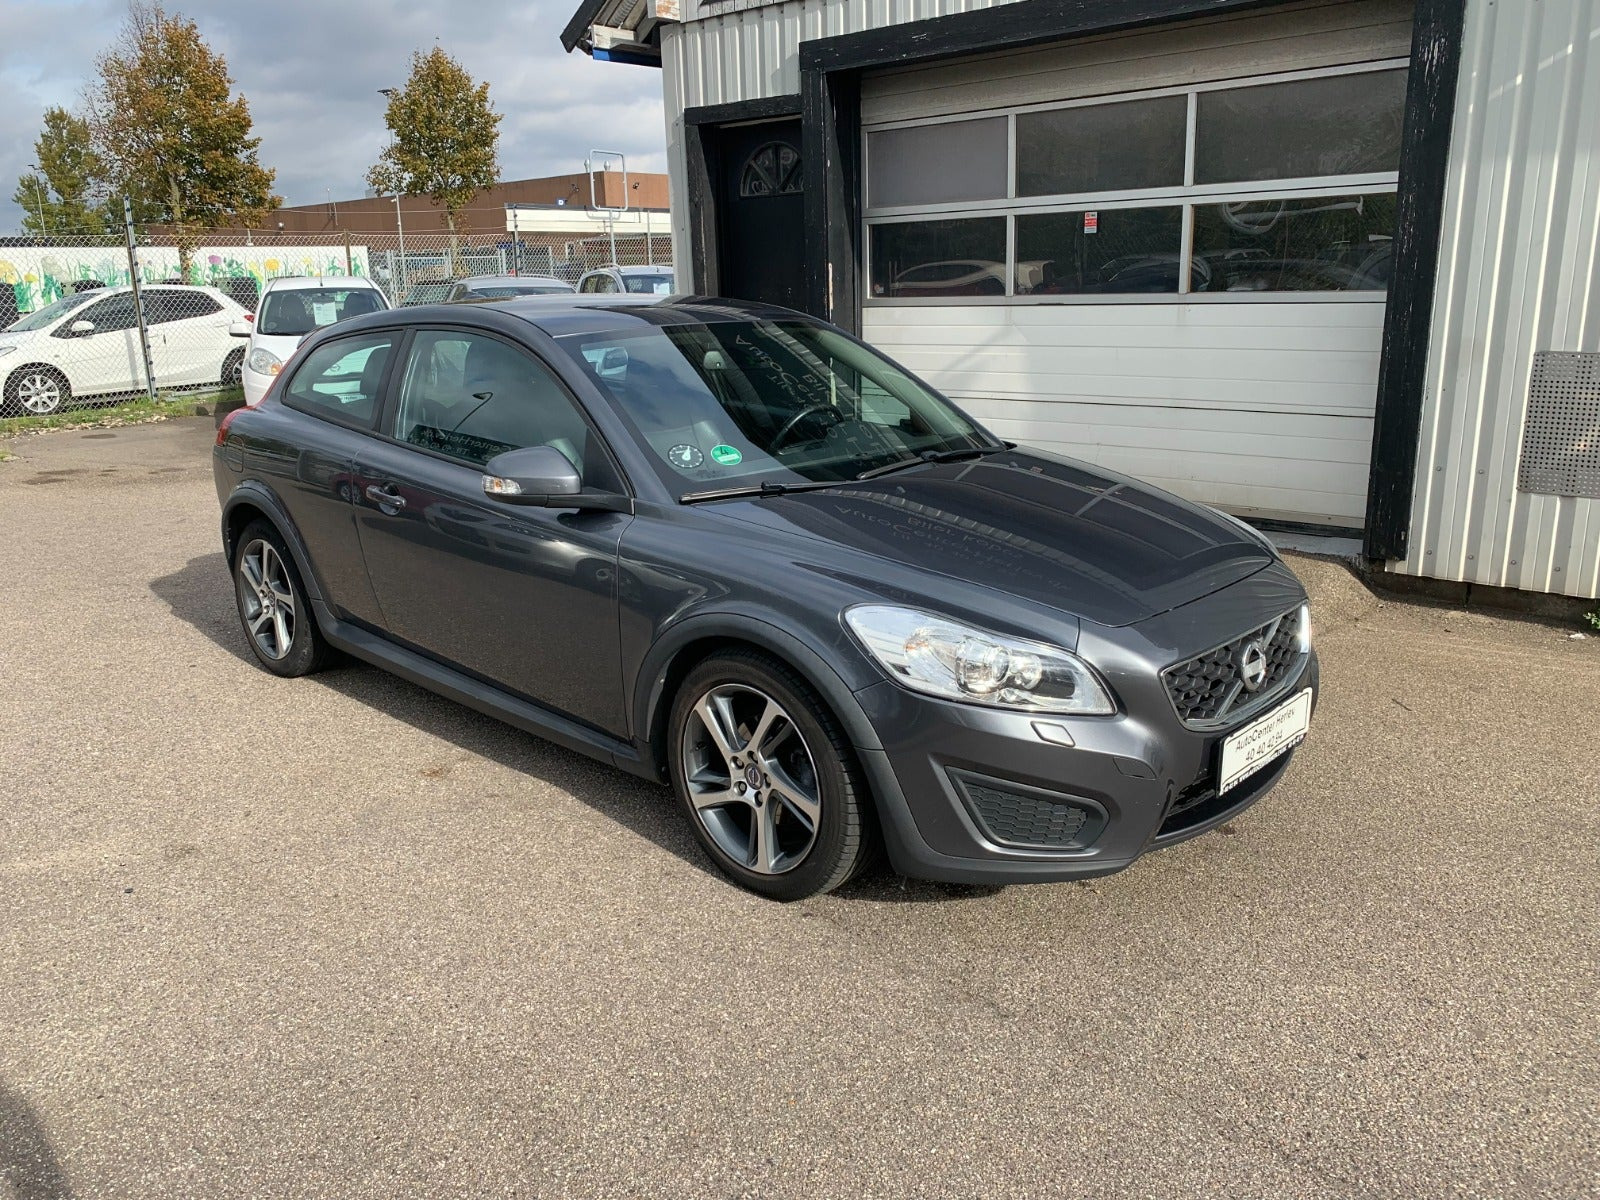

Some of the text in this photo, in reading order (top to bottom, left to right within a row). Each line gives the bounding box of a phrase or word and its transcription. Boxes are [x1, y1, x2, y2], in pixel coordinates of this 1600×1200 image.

[720, 447, 729, 455] 4
[1235, 721, 1276, 751] AutoCenter
[1276, 707, 1296, 724] Herlev
